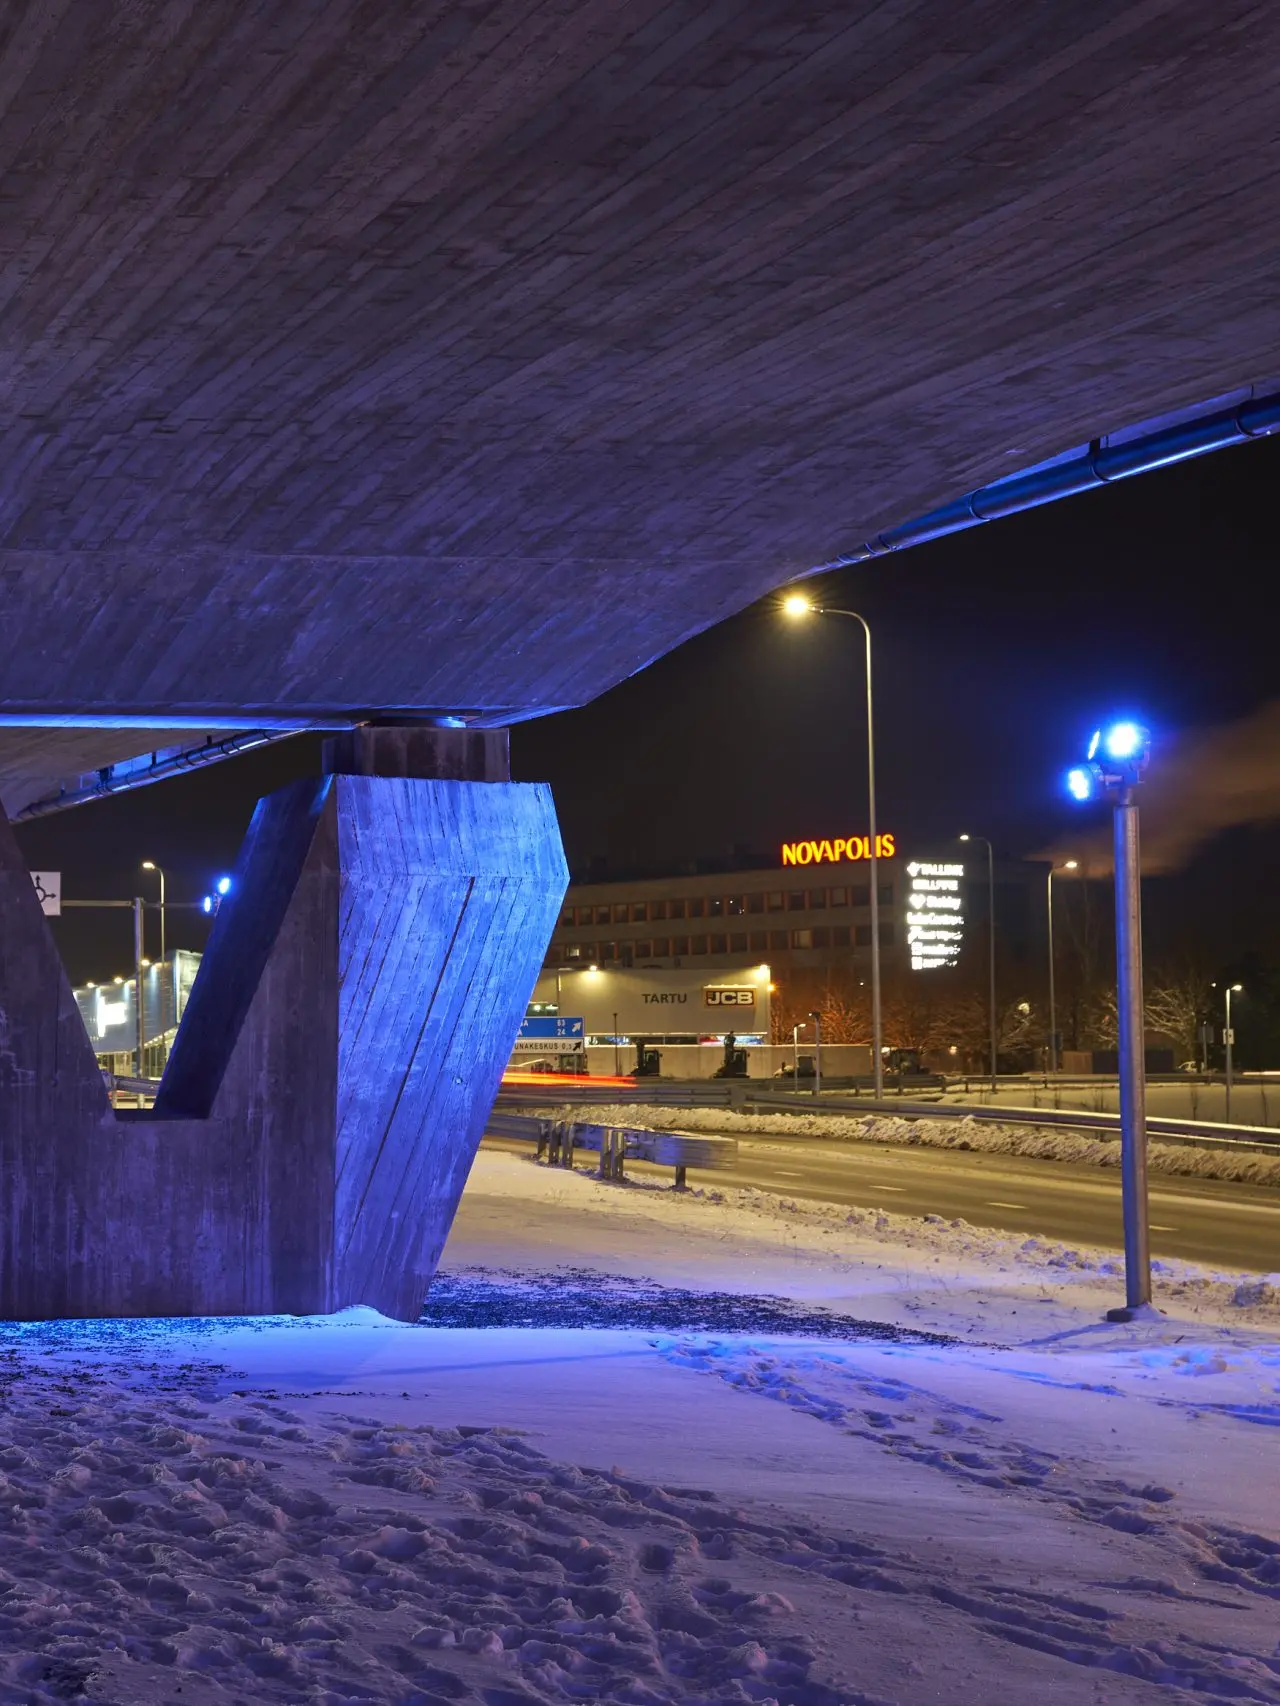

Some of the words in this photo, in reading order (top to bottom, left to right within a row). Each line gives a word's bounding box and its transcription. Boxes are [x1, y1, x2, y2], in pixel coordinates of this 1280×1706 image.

[782, 834, 895, 865] NOVAPOLIS
[642, 993, 687, 1004] TARTU
[707, 991, 754, 1005] JCB
[557, 1028, 566, 1036] 24
